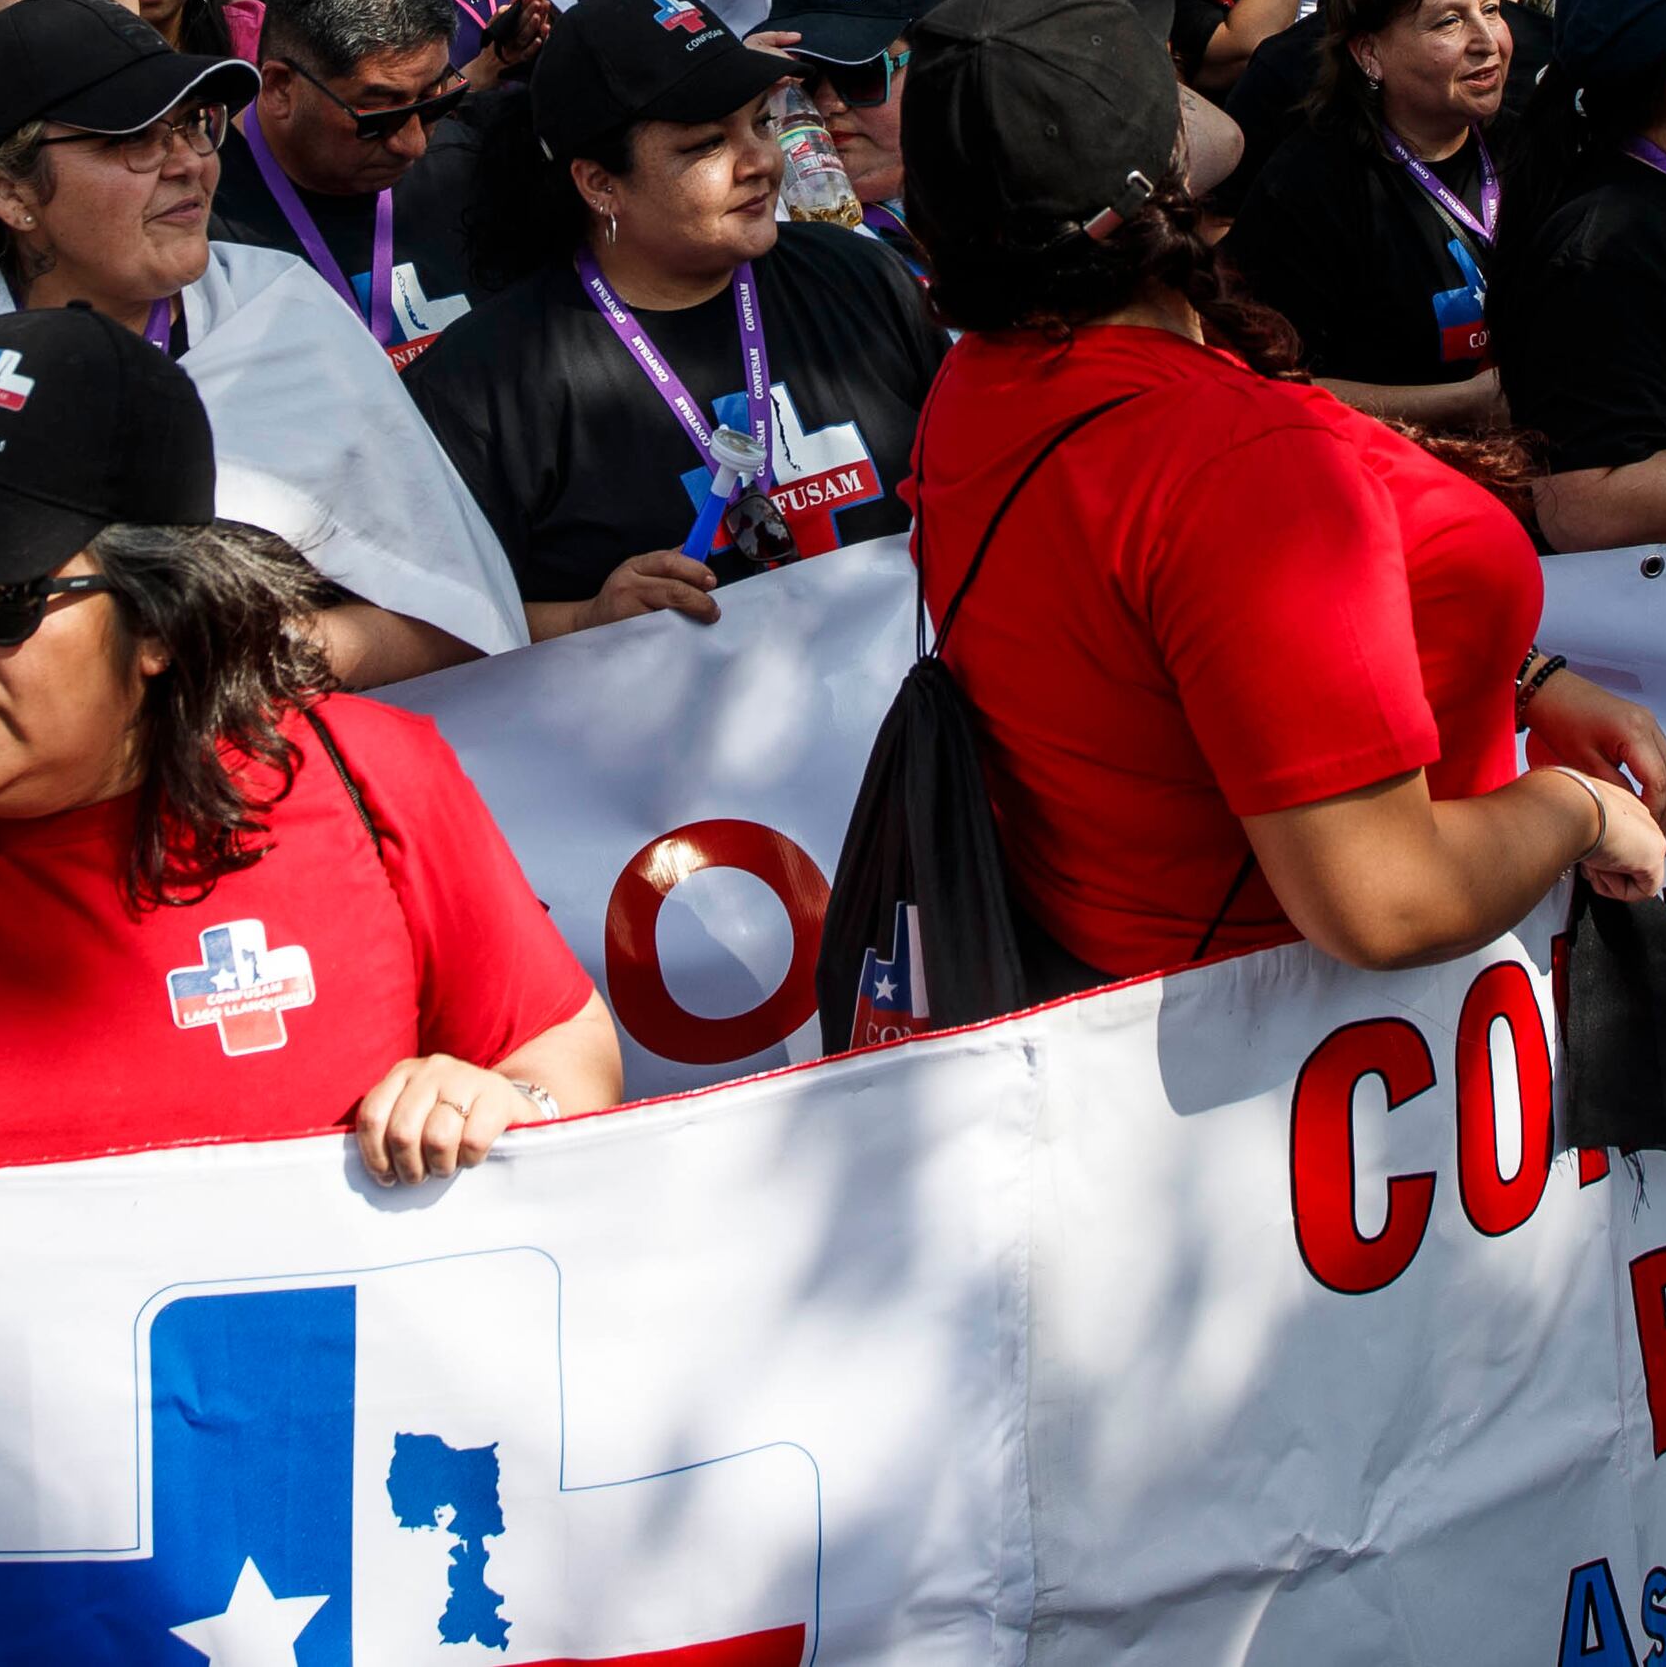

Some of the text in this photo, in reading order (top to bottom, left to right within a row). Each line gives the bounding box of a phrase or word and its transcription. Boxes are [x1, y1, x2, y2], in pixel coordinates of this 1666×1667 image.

[590, 277, 627, 325] CONFUSAM
[739, 282, 756, 332] CONFUSAM
[631, 335, 670, 383] CONFUSAM
[749, 347, 764, 401] CONFUSAM
[674, 396, 712, 447] CONFUSAM
[205, 981, 284, 1006] CONFUSAM
